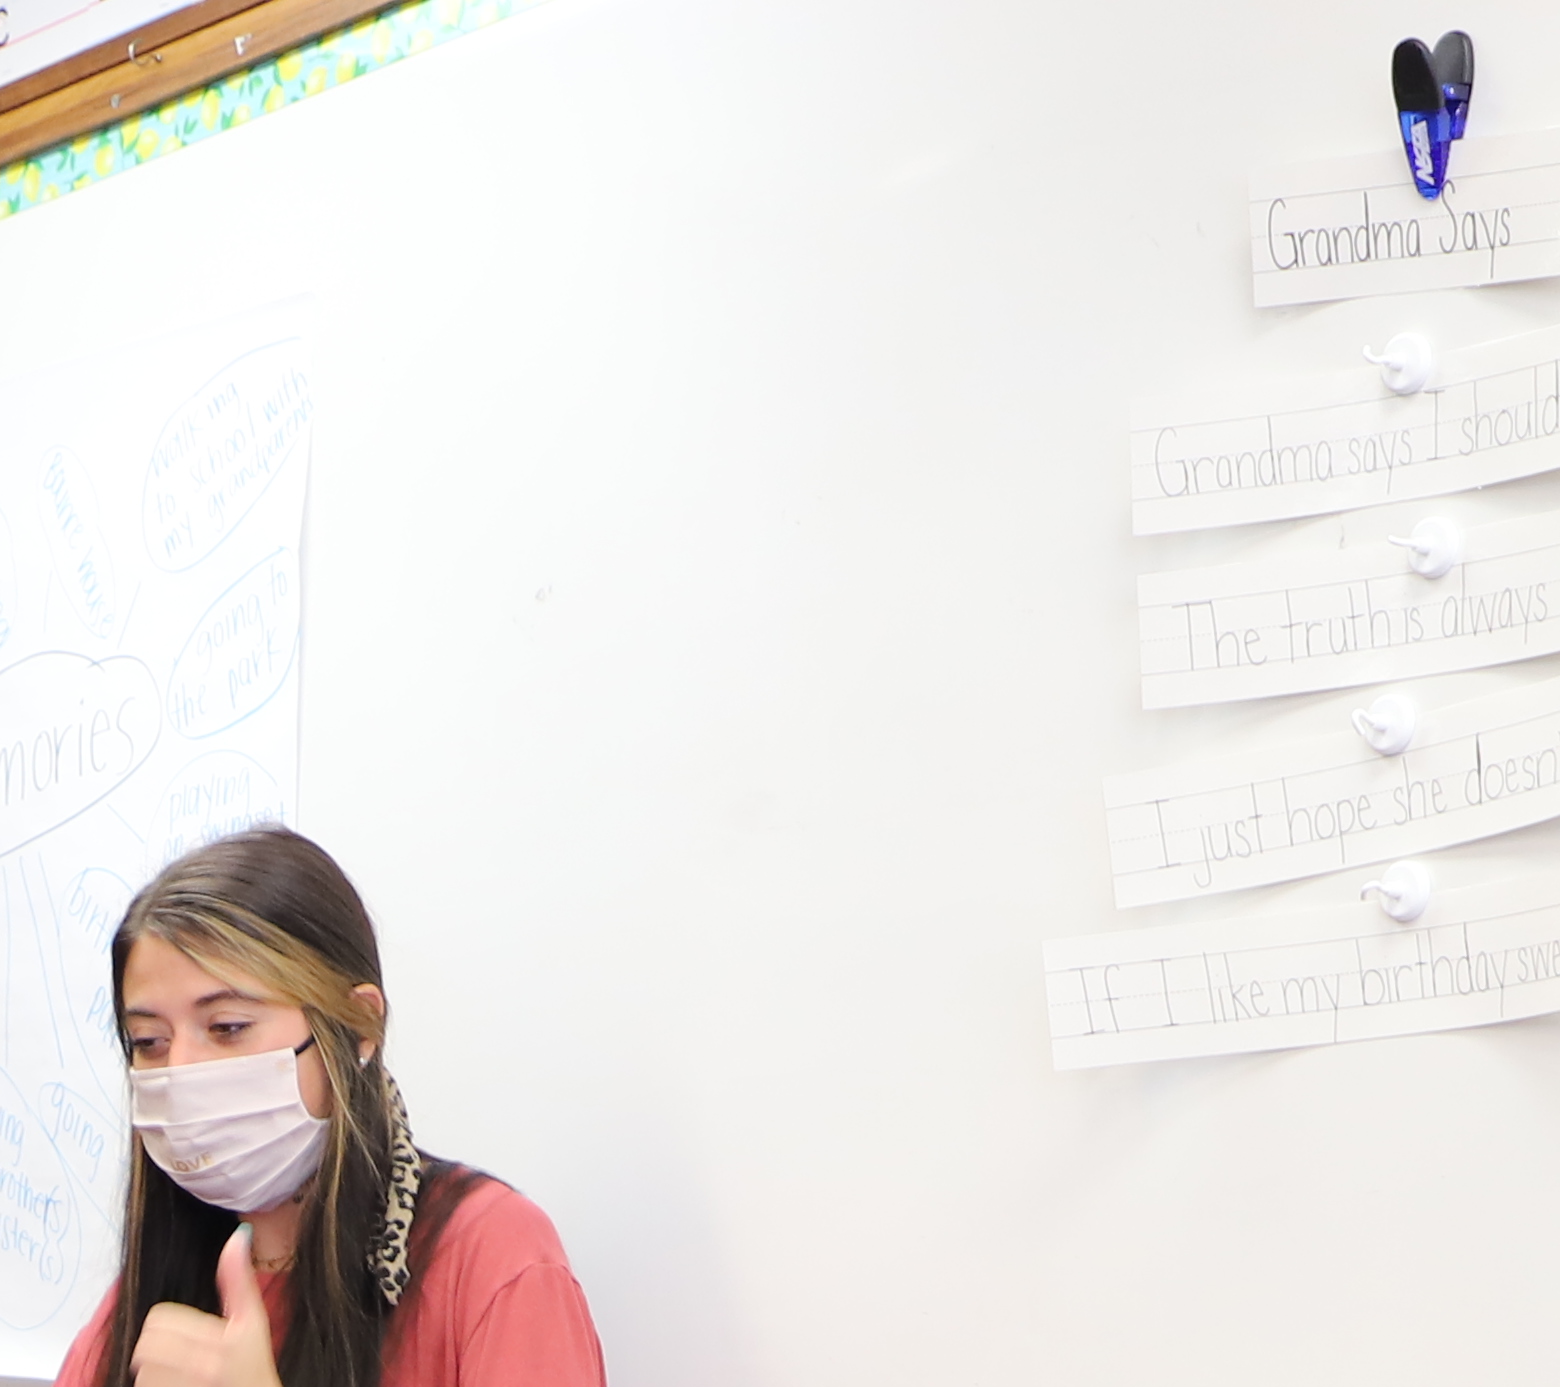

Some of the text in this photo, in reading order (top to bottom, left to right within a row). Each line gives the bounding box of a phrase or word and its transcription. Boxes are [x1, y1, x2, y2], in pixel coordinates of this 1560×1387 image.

[1268, 180, 1511, 279] Grandma Says
[154, 368, 308, 524] to school with
[1155, 416, 1333, 496] Grandma
[1348, 428, 1413, 495] says
[1425, 390, 1446, 461] I
[164, 511, 193, 558] my
[197, 564, 288, 677] going to
[1173, 600, 1268, 670] The
[1280, 580, 1391, 666] truth
[1403, 605, 1424, 643] is
[1442, 564, 1547, 643] always
[171, 627, 280, 729] the park
[169, 767, 250, 834] playing
[1146, 800, 1181, 869] I
[1194, 784, 1265, 889] just
[1283, 778, 1376, 864] hope
[1393, 757, 1446, 827] she
[1070, 966, 1121, 1035] If
[1152, 959, 1180, 1026] I
[1203, 953, 1269, 1024] like
[1283, 974, 1344, 1044] my
[1357, 921, 1509, 1019] birthday
[51, 1084, 105, 1184] going
